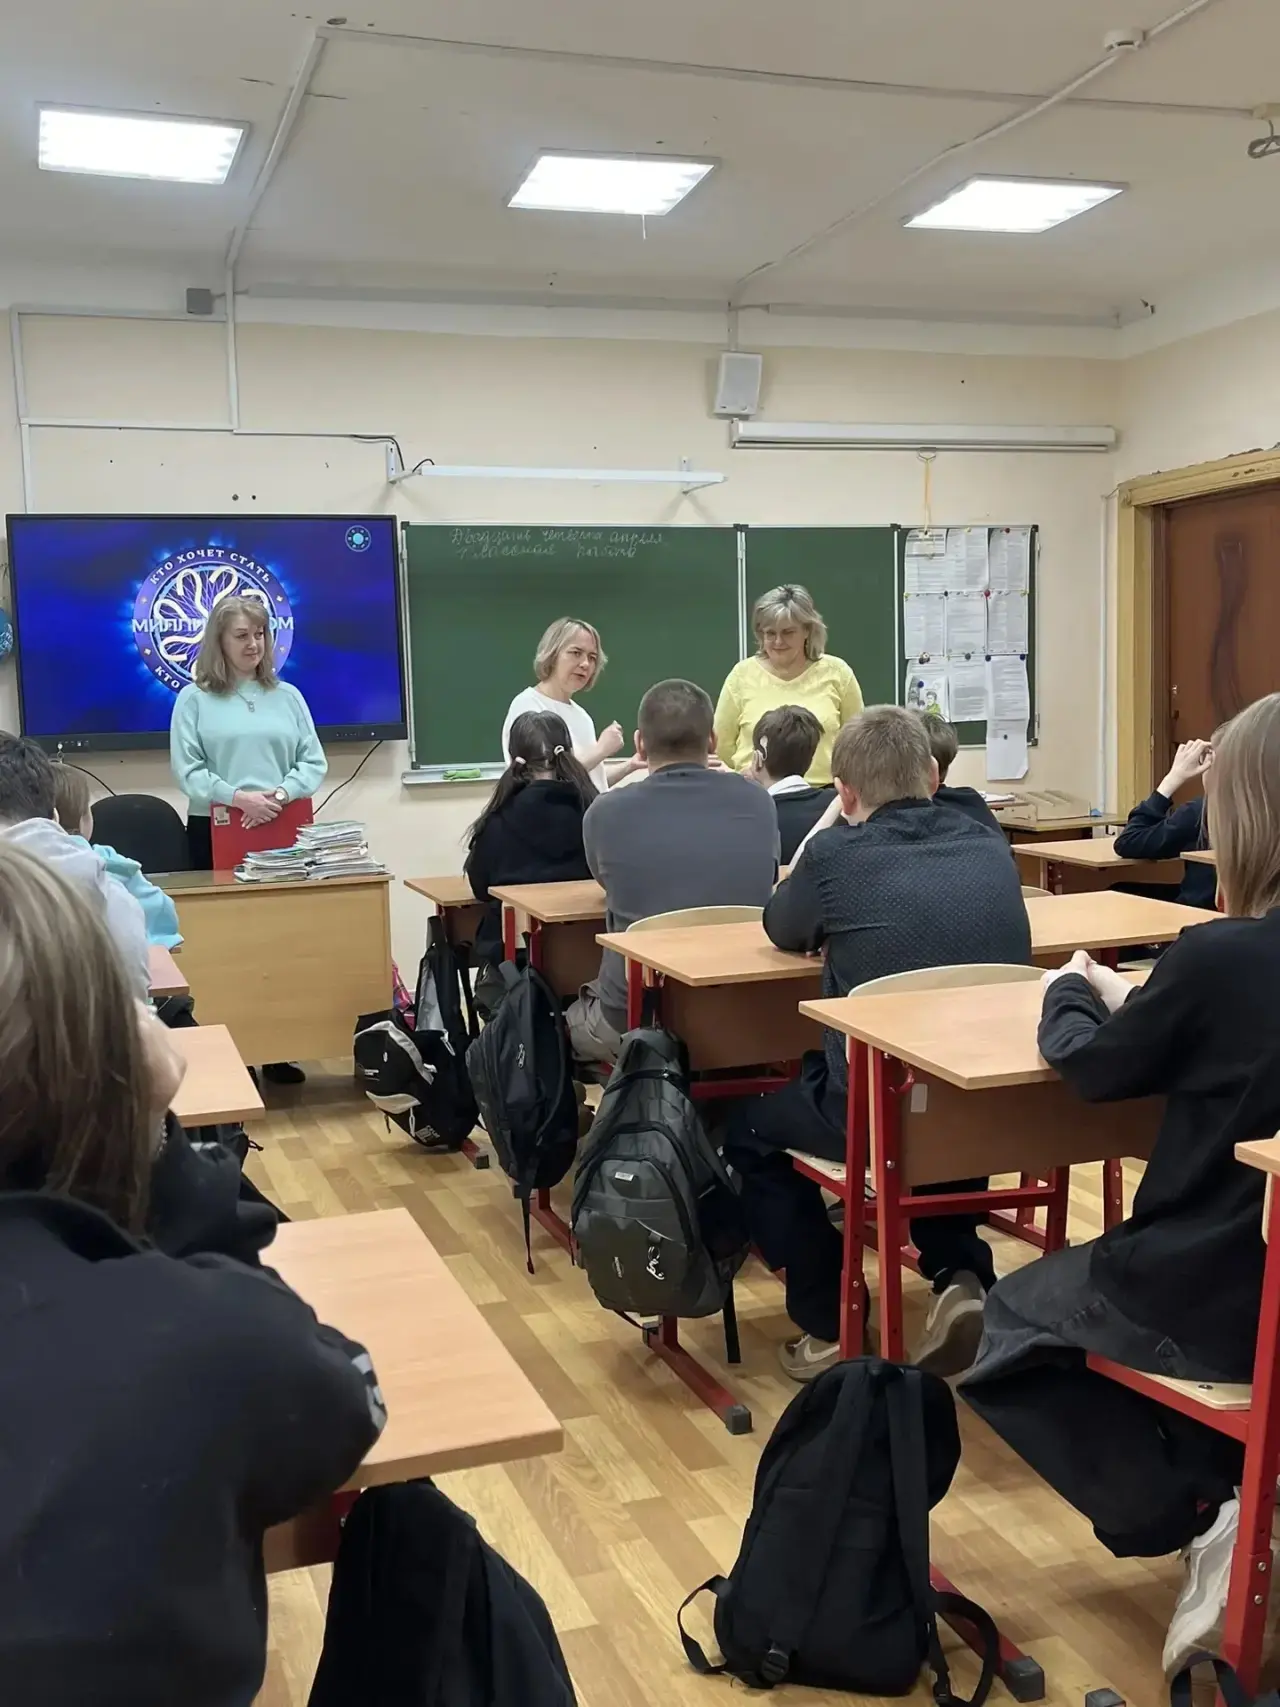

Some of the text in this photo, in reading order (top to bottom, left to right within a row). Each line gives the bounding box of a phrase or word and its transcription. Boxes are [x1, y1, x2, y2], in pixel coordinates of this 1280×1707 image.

[150, 549, 270, 585] КТО ХОЧЕТ СТАТЬ
[132, 616, 294, 633] МИЛЛИОМ
[155, 665, 181, 689] КТО
